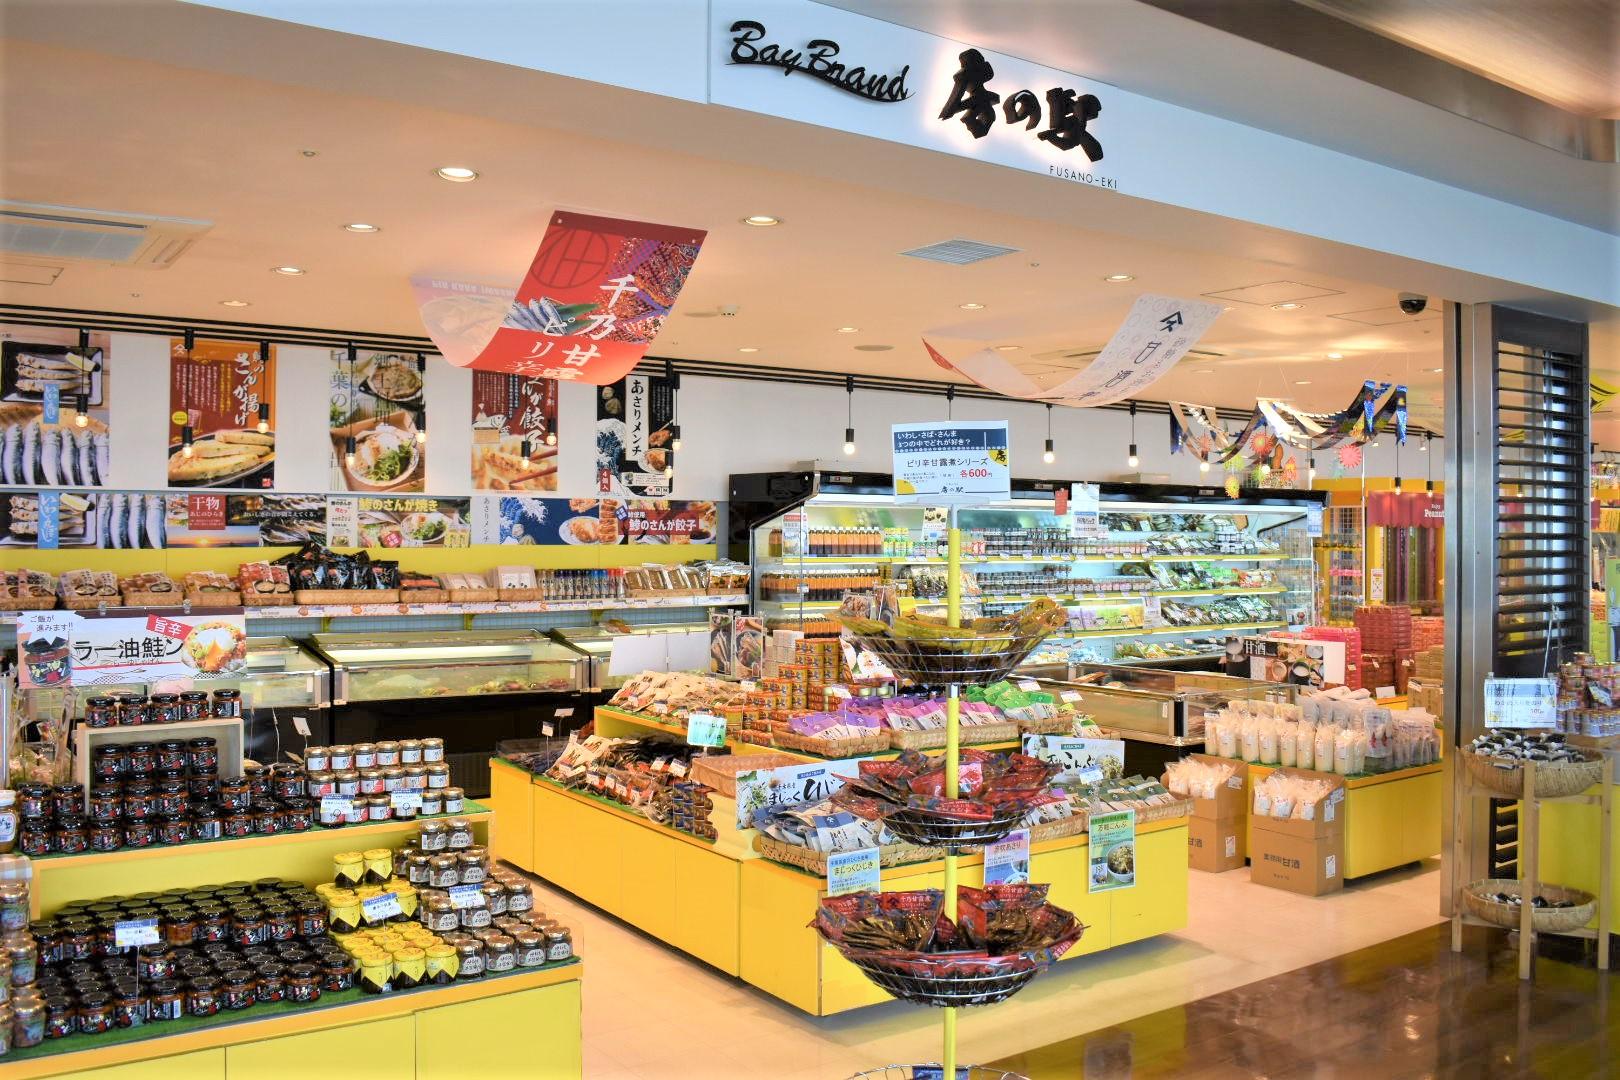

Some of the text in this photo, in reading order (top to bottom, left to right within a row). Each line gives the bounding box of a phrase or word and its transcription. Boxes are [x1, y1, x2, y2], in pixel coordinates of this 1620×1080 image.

[725, 20, 910, 103] Bay Brand
[938, 48, 1105, 163] 房の駅
[1049, 165, 1119, 190] FUSANO-EKI
[631, 380, 644, 456] あさりメンチ
[907, 458, 988, 468] ピリ辛甘露煮シリーズ
[191, 496, 220, 510] 干物
[73, 637, 185, 662] ラー油鮭ン
[1245, 640, 1266, 655] 甘酒
